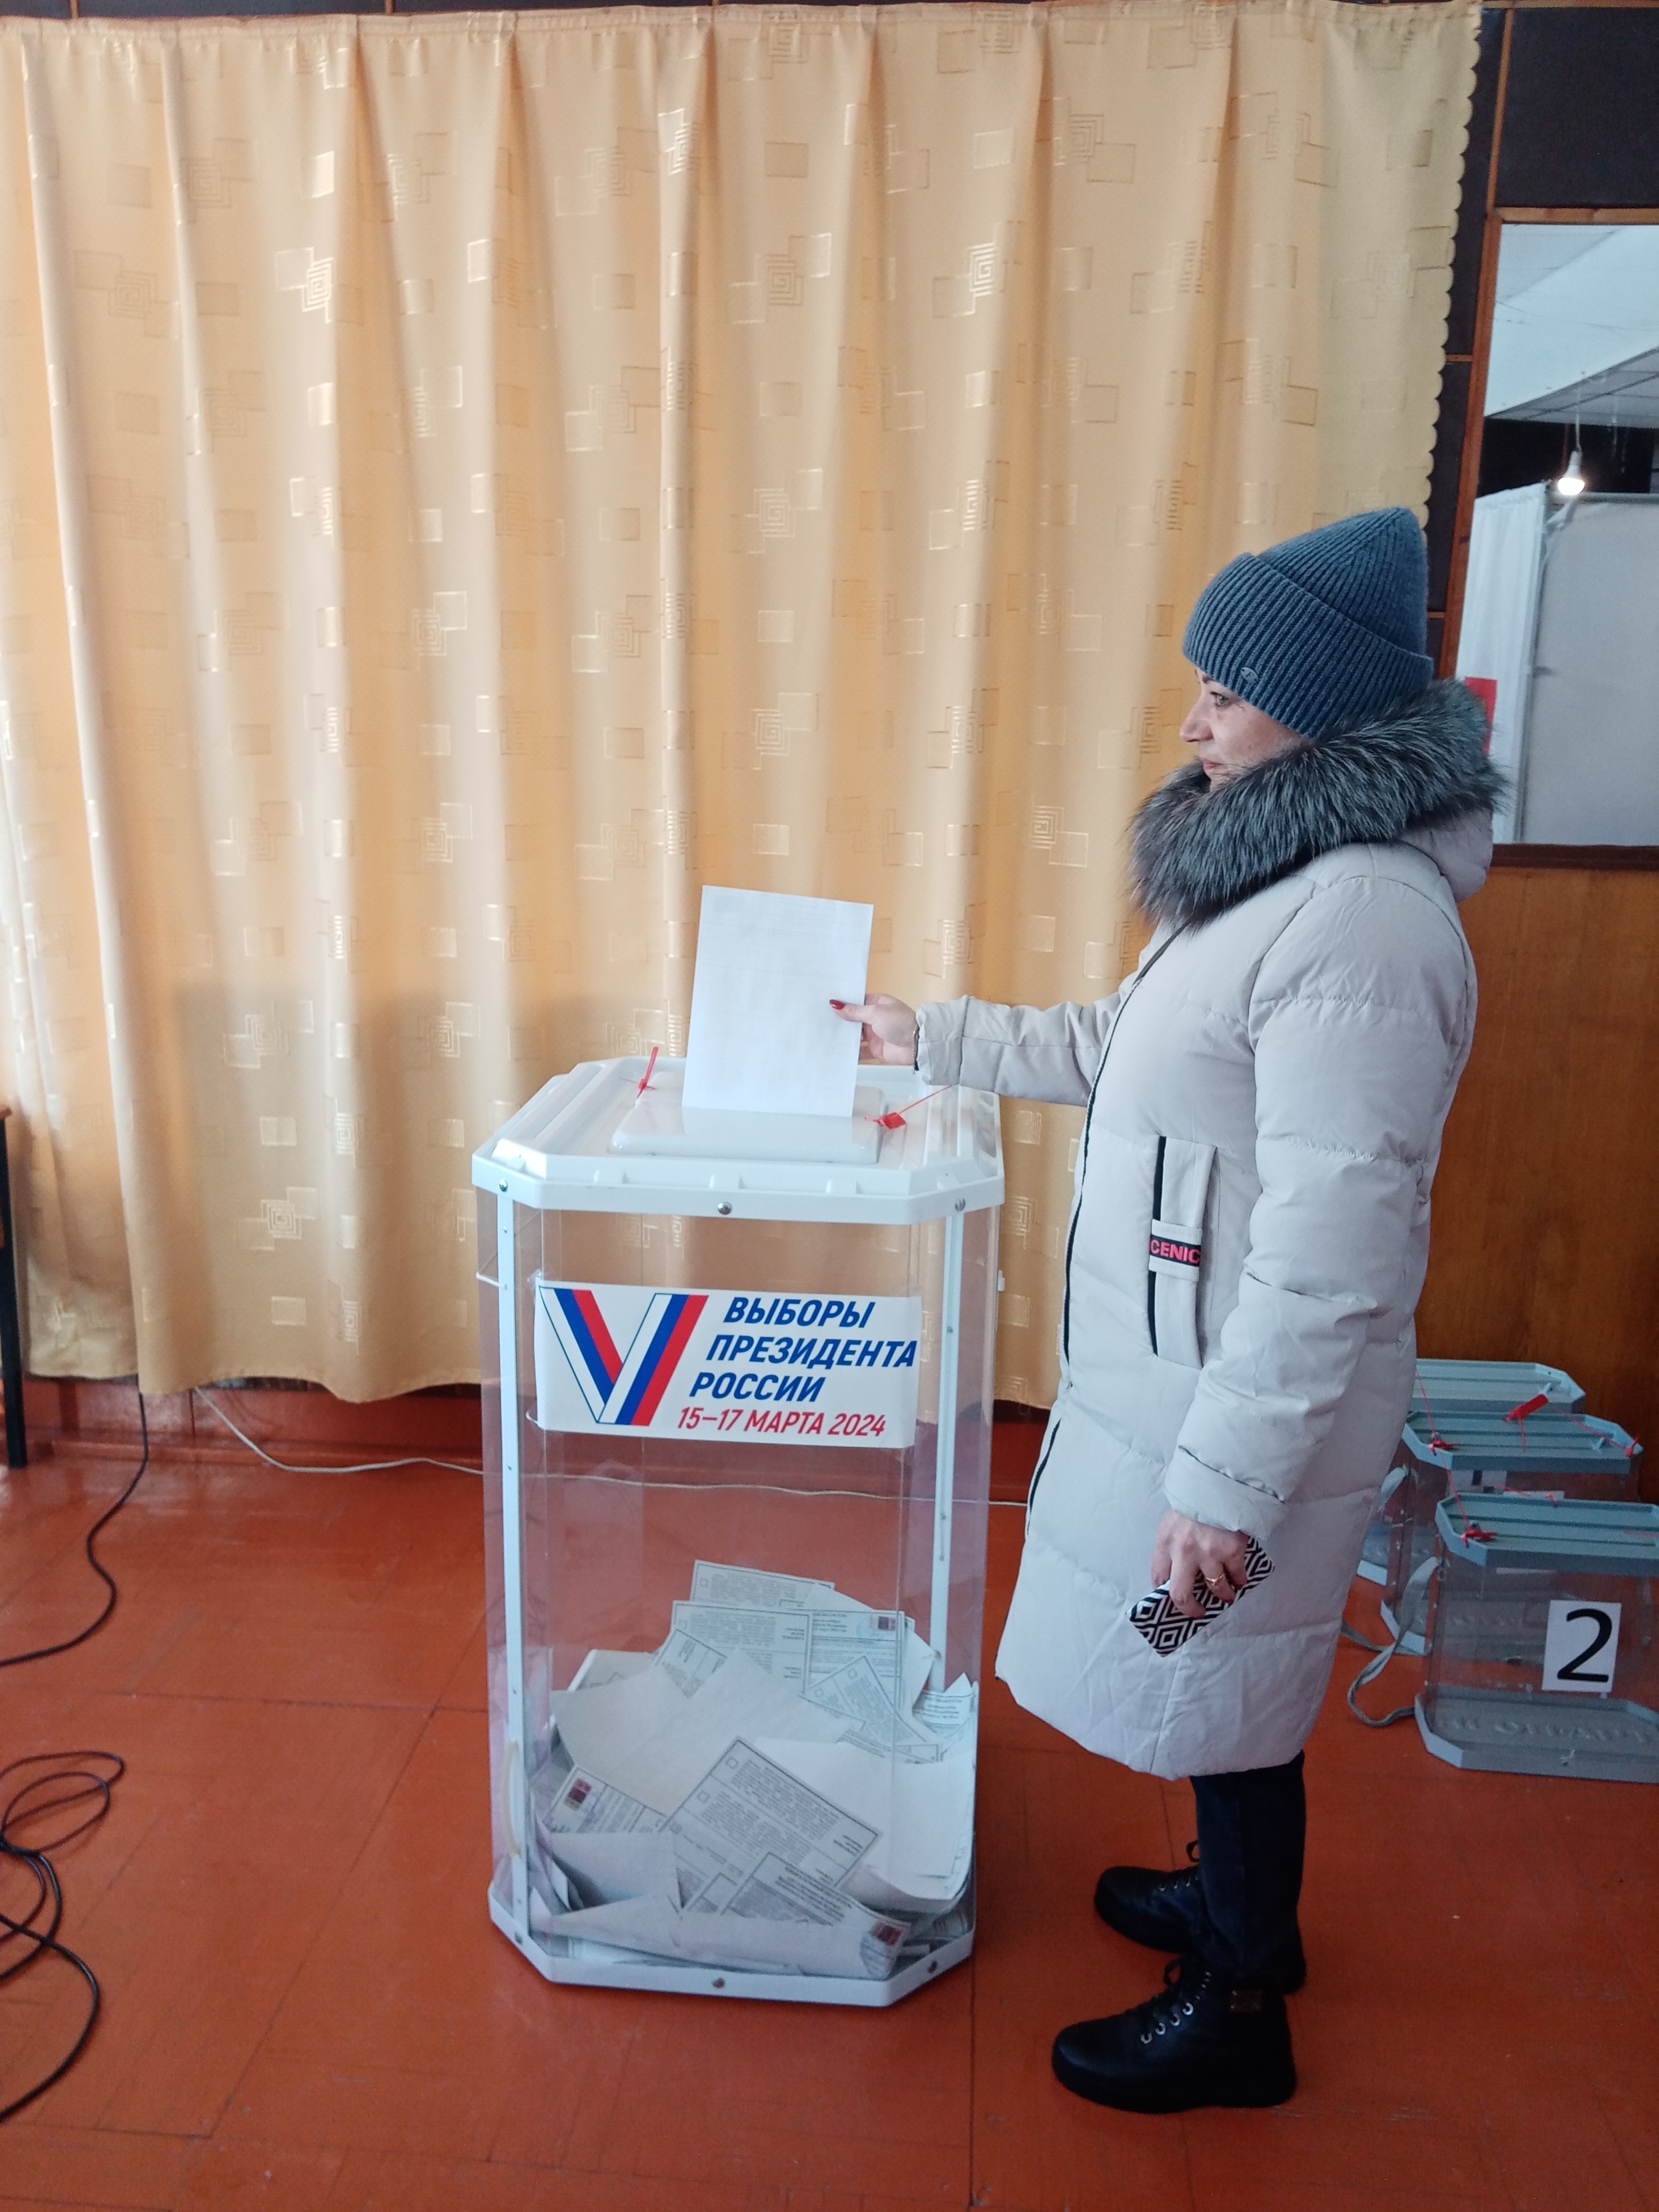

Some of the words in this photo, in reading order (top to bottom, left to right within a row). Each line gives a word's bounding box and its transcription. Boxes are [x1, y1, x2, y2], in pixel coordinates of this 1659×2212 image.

[723, 1296, 876, 1328] ВЫБОРЫ
[706, 1334, 918, 1370] ПРЕЗИДЕНТА
[689, 1372, 826, 1403] РОССИИ
[745, 1410, 825, 1435] МАРТА
[827, 1413, 886, 1437] 2024
[1556, 1607, 1613, 1683] 2
